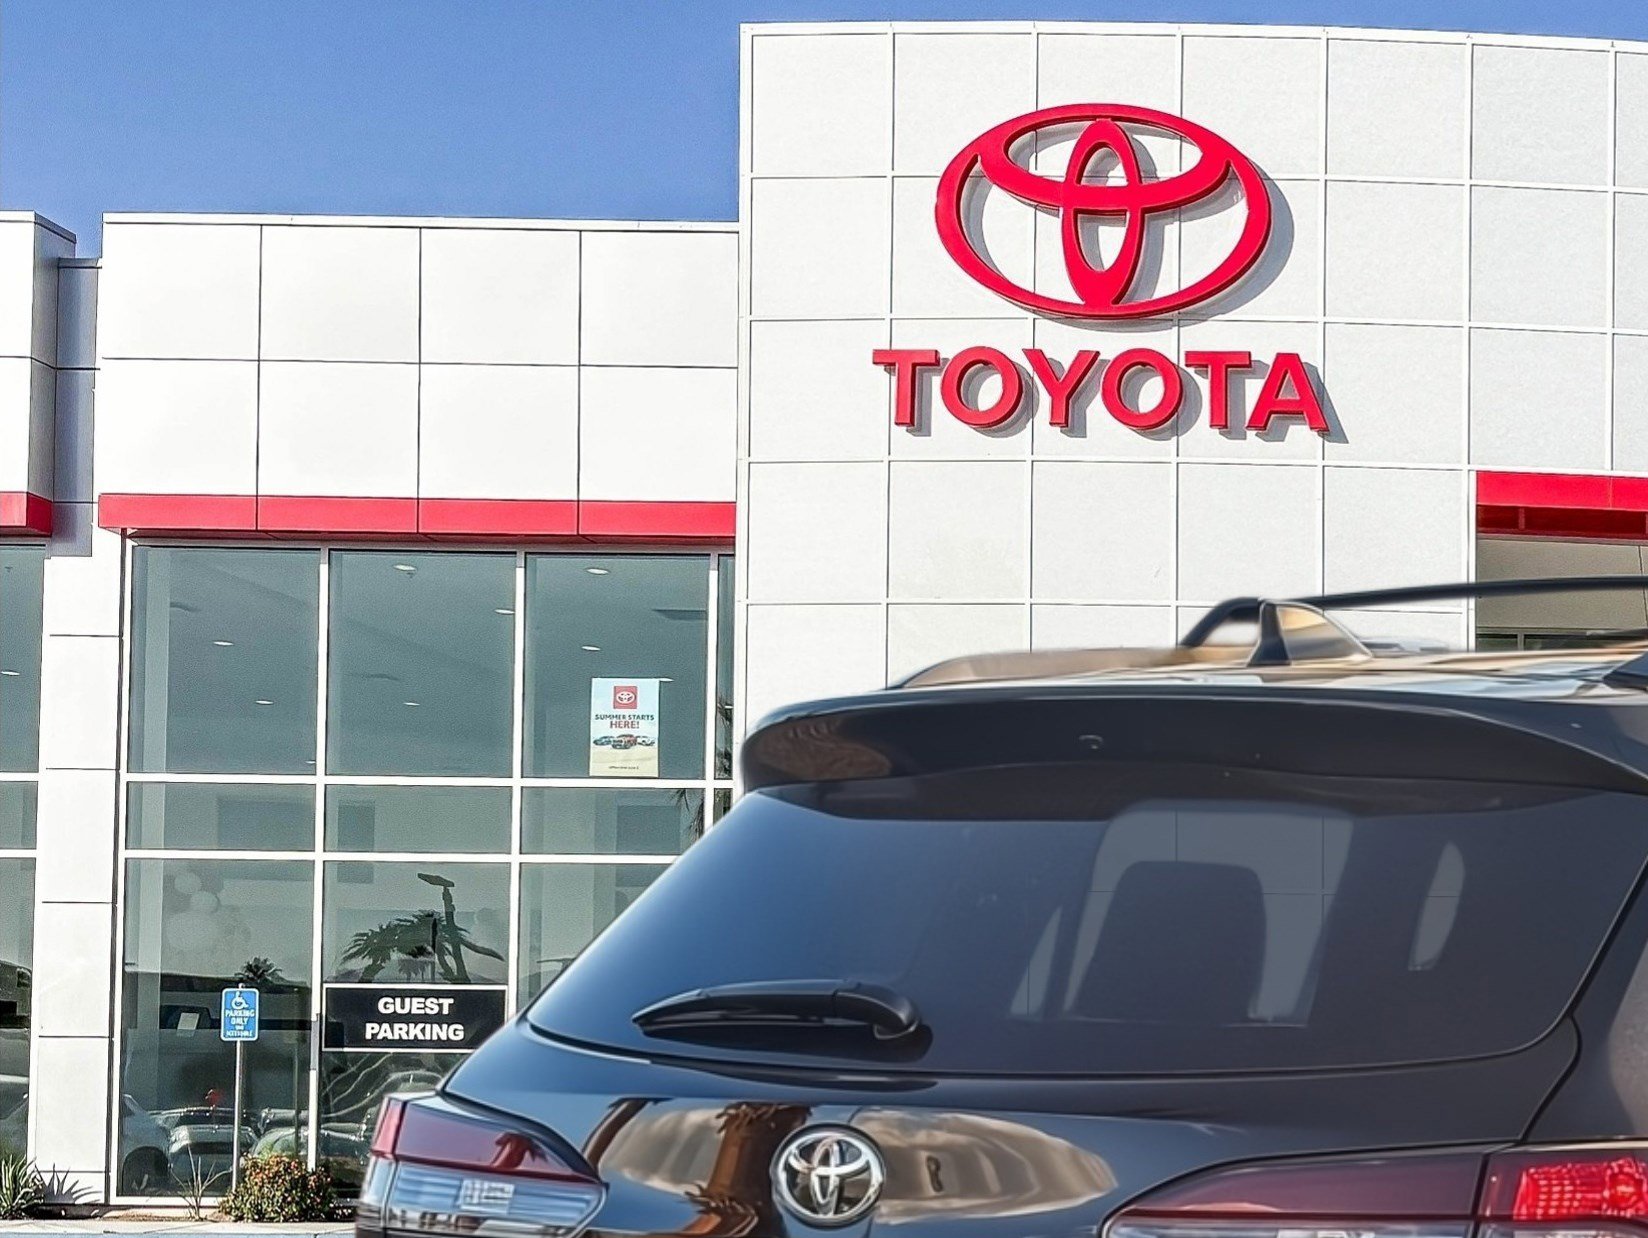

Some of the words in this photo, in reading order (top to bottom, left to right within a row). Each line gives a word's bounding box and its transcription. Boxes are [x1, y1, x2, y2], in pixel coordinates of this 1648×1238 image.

[873, 346, 1330, 433] TOYOTA
[610, 720, 640, 729] HERE!
[378, 997, 454, 1015] GUEST
[231, 1017, 249, 1025] ONLY
[365, 1023, 464, 1041] PARKING
